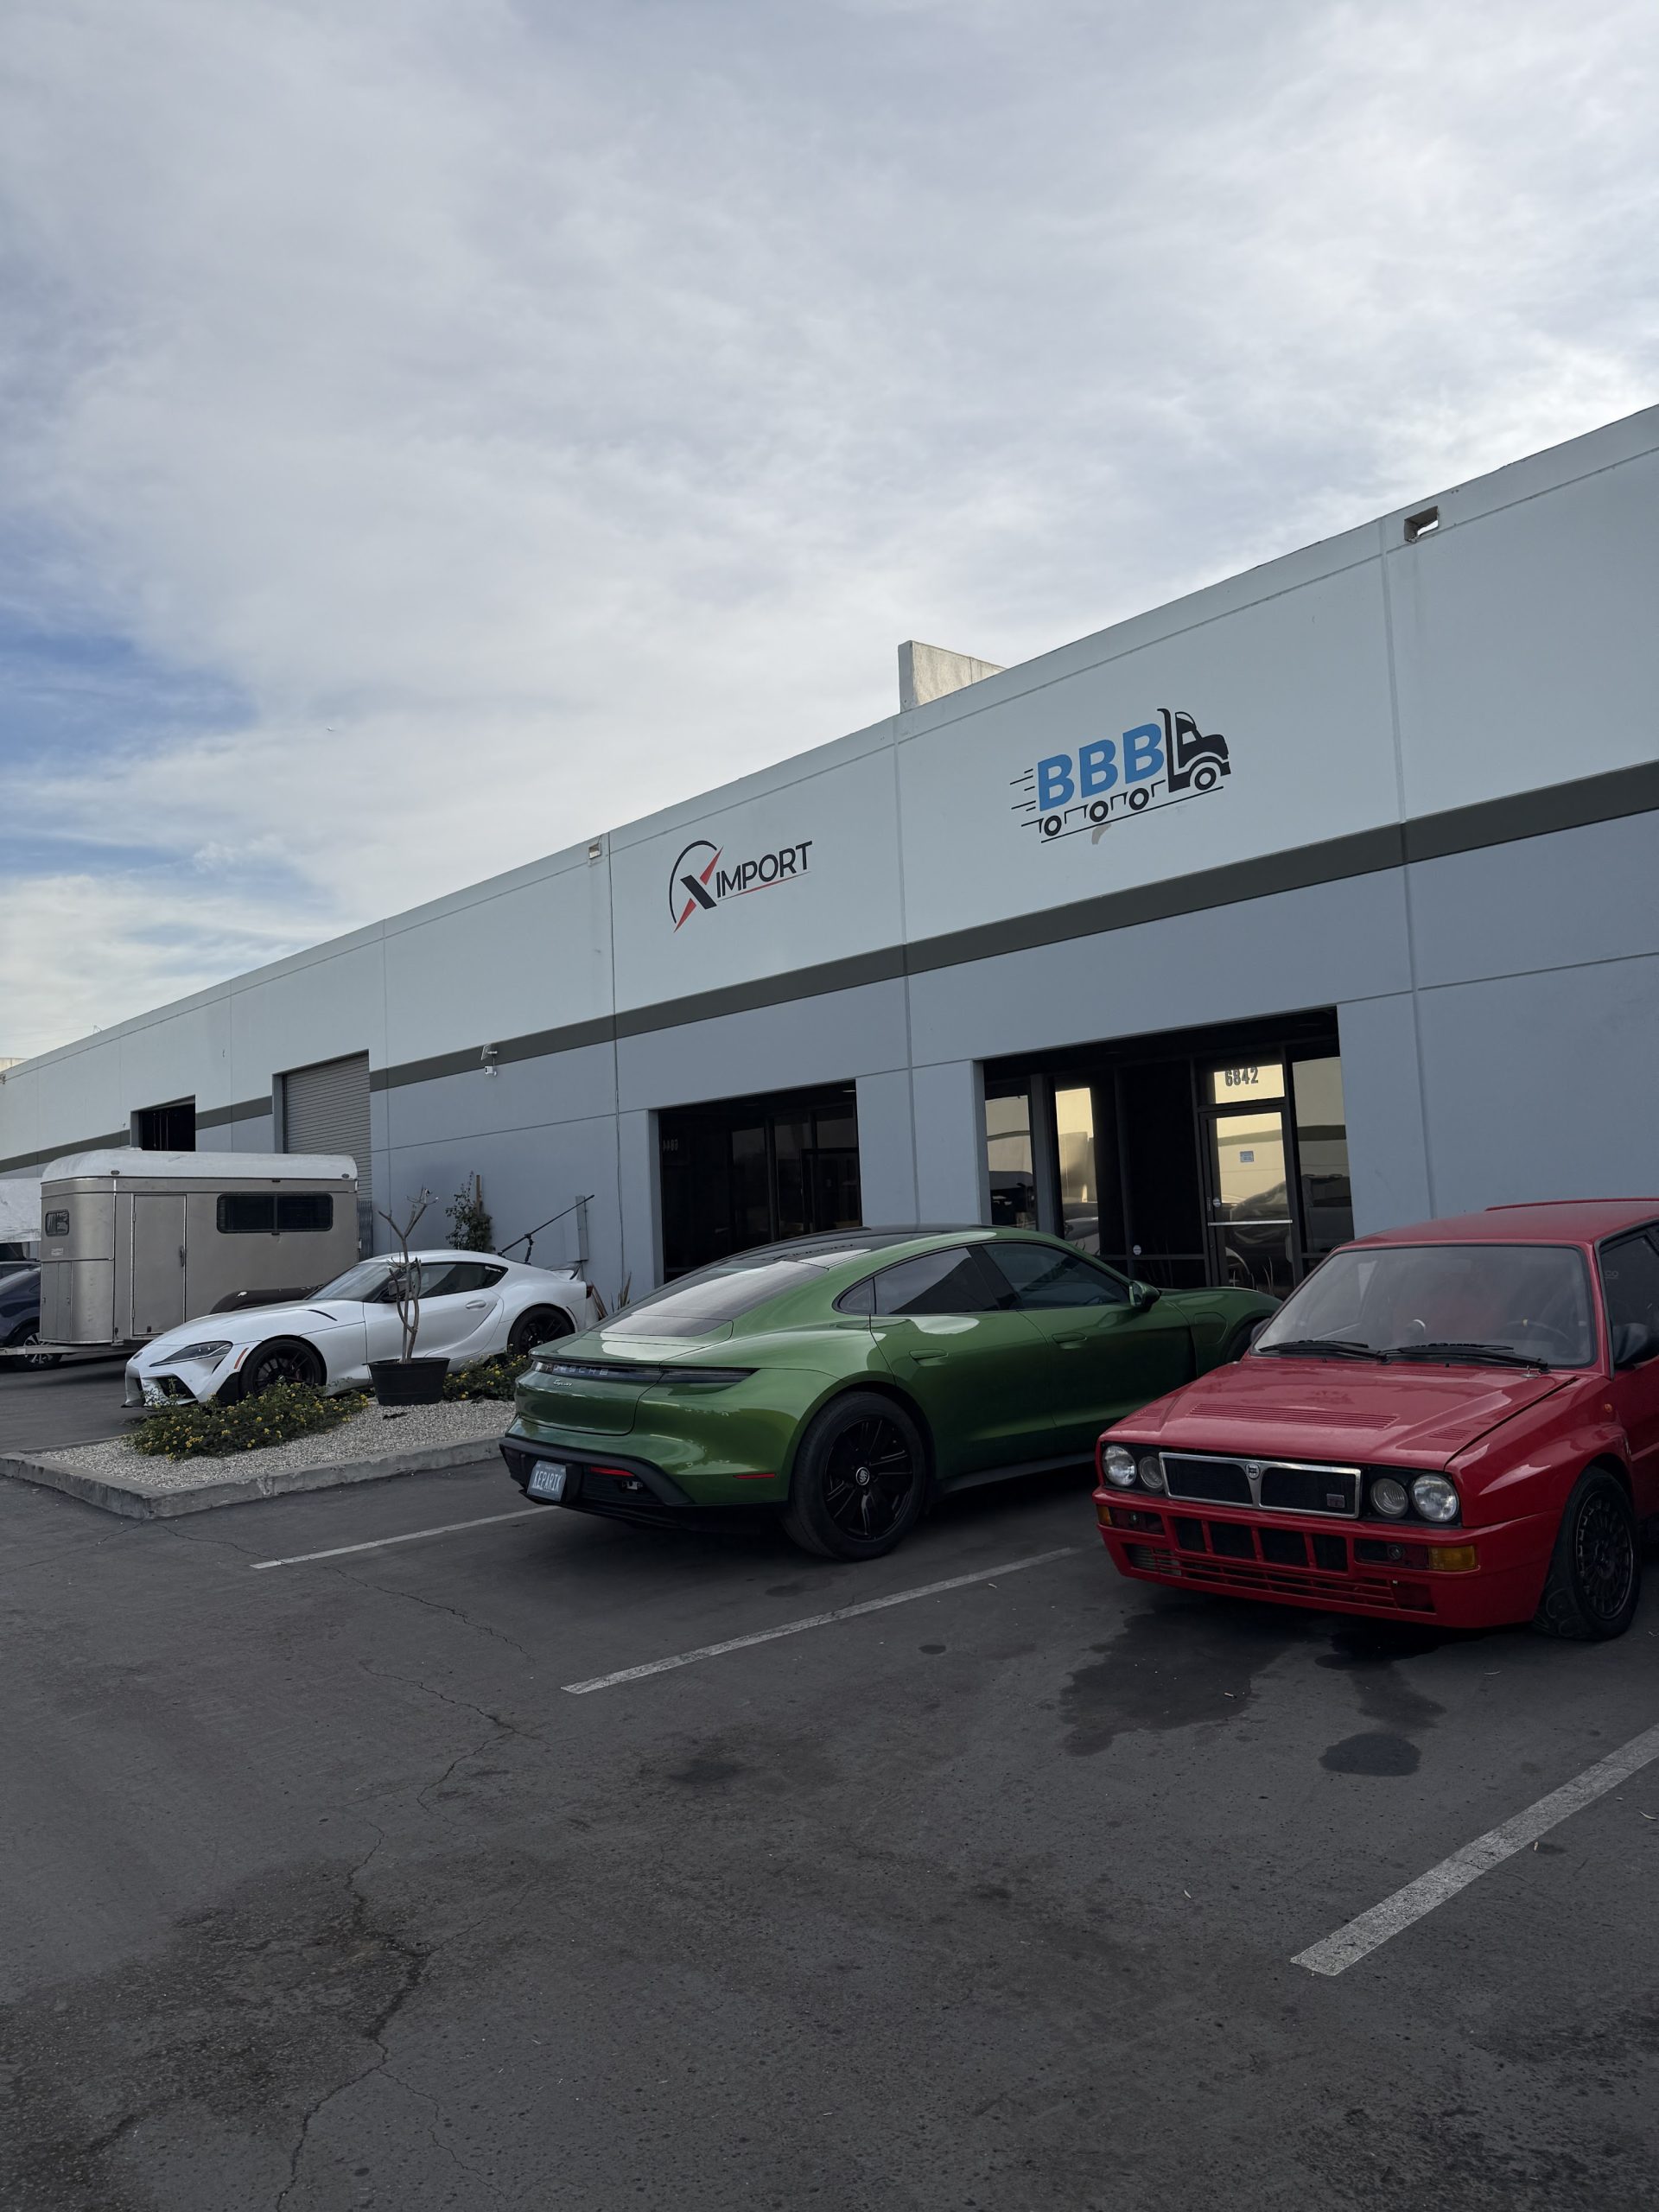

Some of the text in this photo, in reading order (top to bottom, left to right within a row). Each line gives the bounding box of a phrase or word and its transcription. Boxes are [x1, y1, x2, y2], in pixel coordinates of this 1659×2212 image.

[1037, 722, 1165, 812] BBB
[1224, 1066, 1259, 1087] 6842
[545, 1363, 608, 1376] PORSCHE
